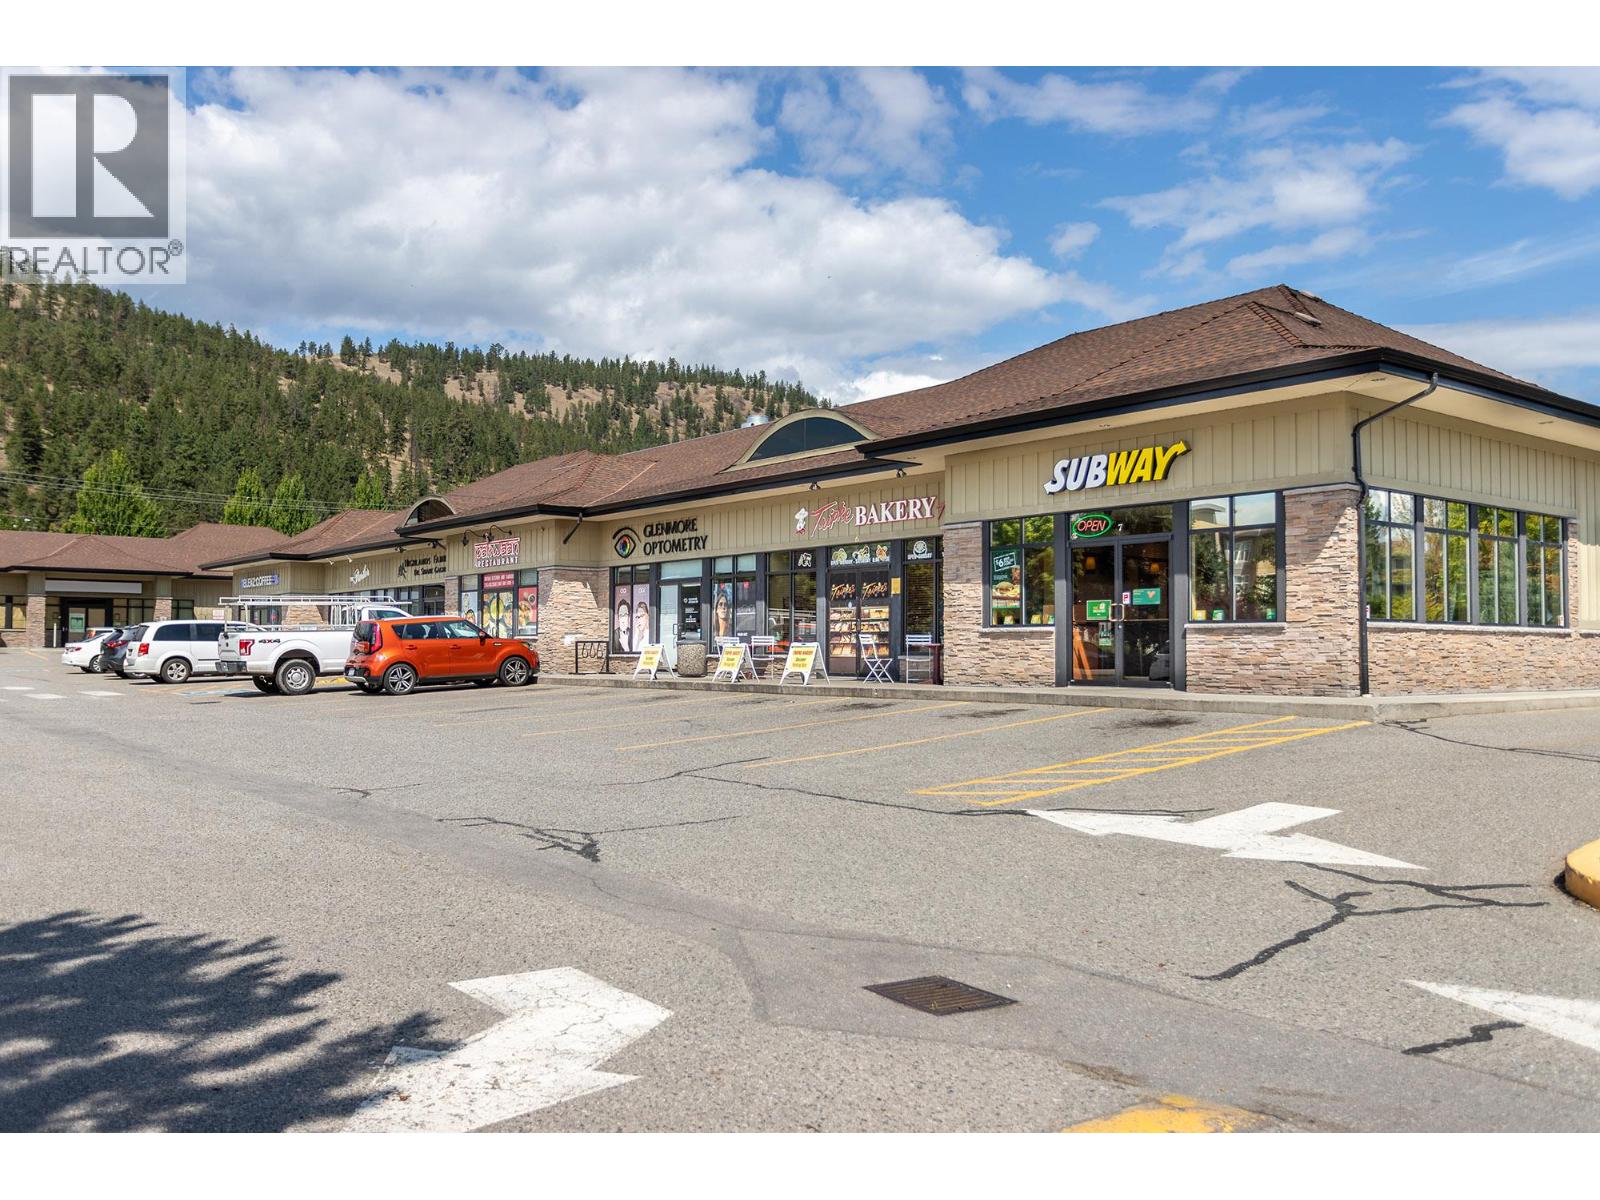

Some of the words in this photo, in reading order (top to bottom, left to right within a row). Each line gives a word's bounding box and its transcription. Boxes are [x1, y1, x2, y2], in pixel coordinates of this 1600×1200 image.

[1044, 440, 1190, 495] SUBWAY
[854, 497, 936, 527] BAKERY
[643, 518, 697, 537] GLENMORE
[1077, 520, 1107, 532] OPEN
[643, 535, 708, 556] OPTOMETRY
[476, 556, 518, 567] RESTAURANT
